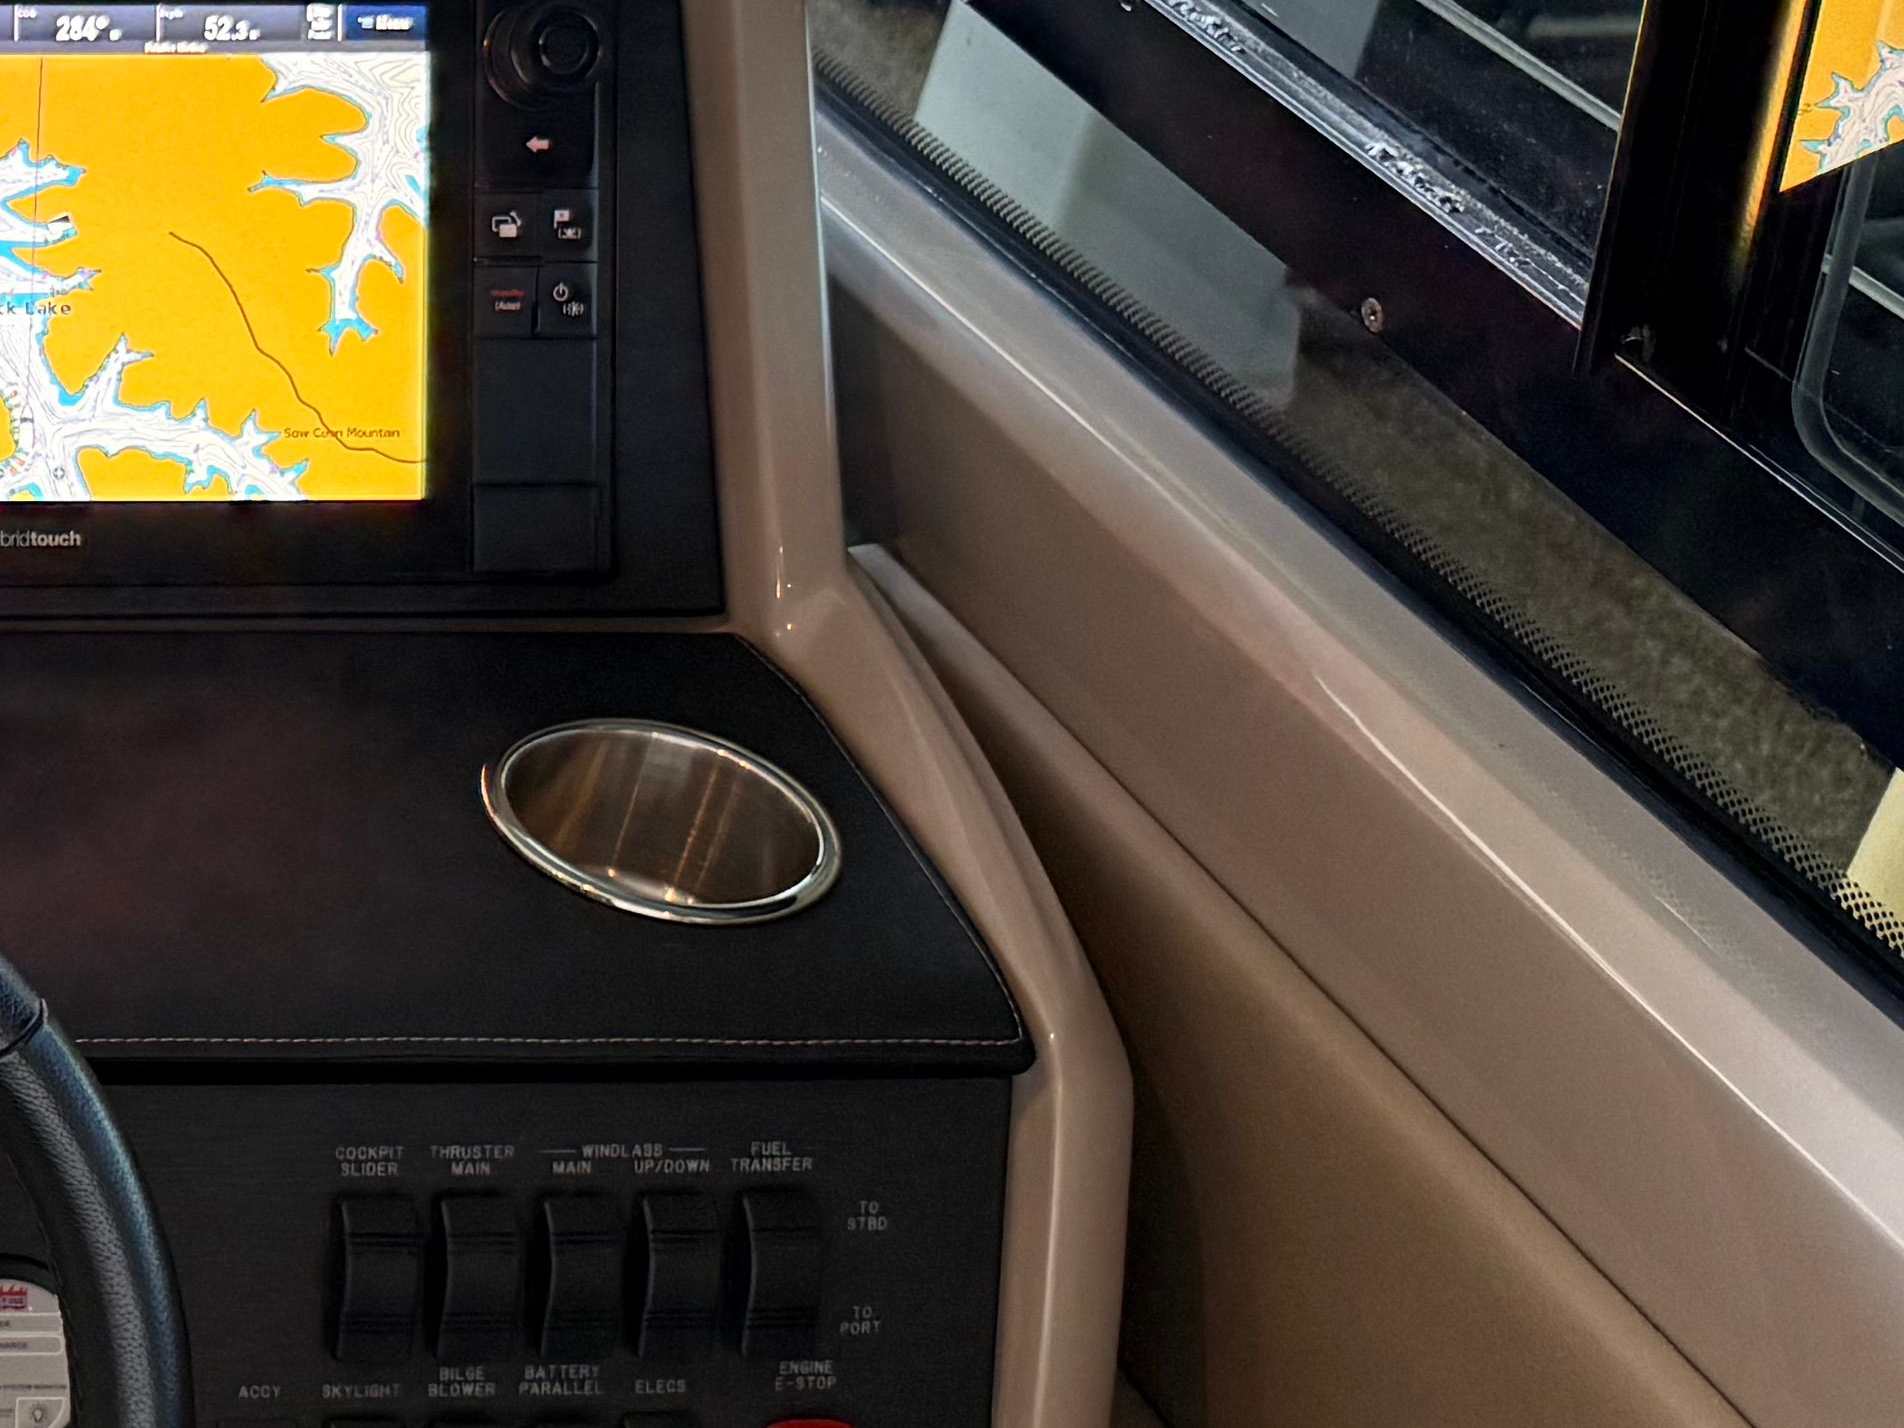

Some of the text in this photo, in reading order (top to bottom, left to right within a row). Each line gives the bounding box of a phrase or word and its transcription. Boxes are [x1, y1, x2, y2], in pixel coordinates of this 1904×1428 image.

[26, 302, 72, 315] Lake
[347, 427, 400, 438] Mountain
[335, 1146, 405, 1161] COCKPIT
[430, 1145, 515, 1159] THRUSTER
[582, 1143, 664, 1158] WINDLASS
[751, 1142, 792, 1157] FUEL
[340, 1162, 399, 1177] SLIDER
[451, 1161, 492, 1176] MAIN
[552, 1160, 592, 1175] MAIN
[634, 1159, 711, 1174] UP/DOWN
[731, 1157, 813, 1173] TRANSFER
[860, 1201, 879, 1214] TO
[847, 1216, 888, 1230] STBD
[853, 1306, 873, 1319] TO
[839, 1320, 882, 1335] PORT
[439, 1366, 485, 1381] BILGE
[524, 1364, 600, 1379] BATTERY
[779, 1360, 834, 1374] ENGINE
[428, 1382, 496, 1397] BLOWER
[519, 1380, 602, 1396] PARALLEL
[635, 1380, 687, 1394] ELECS
[775, 1376, 836, 1391] E-STOP
[239, 1386, 281, 1399] ACCY
[322, 1384, 401, 1399] SKYLIGHT
